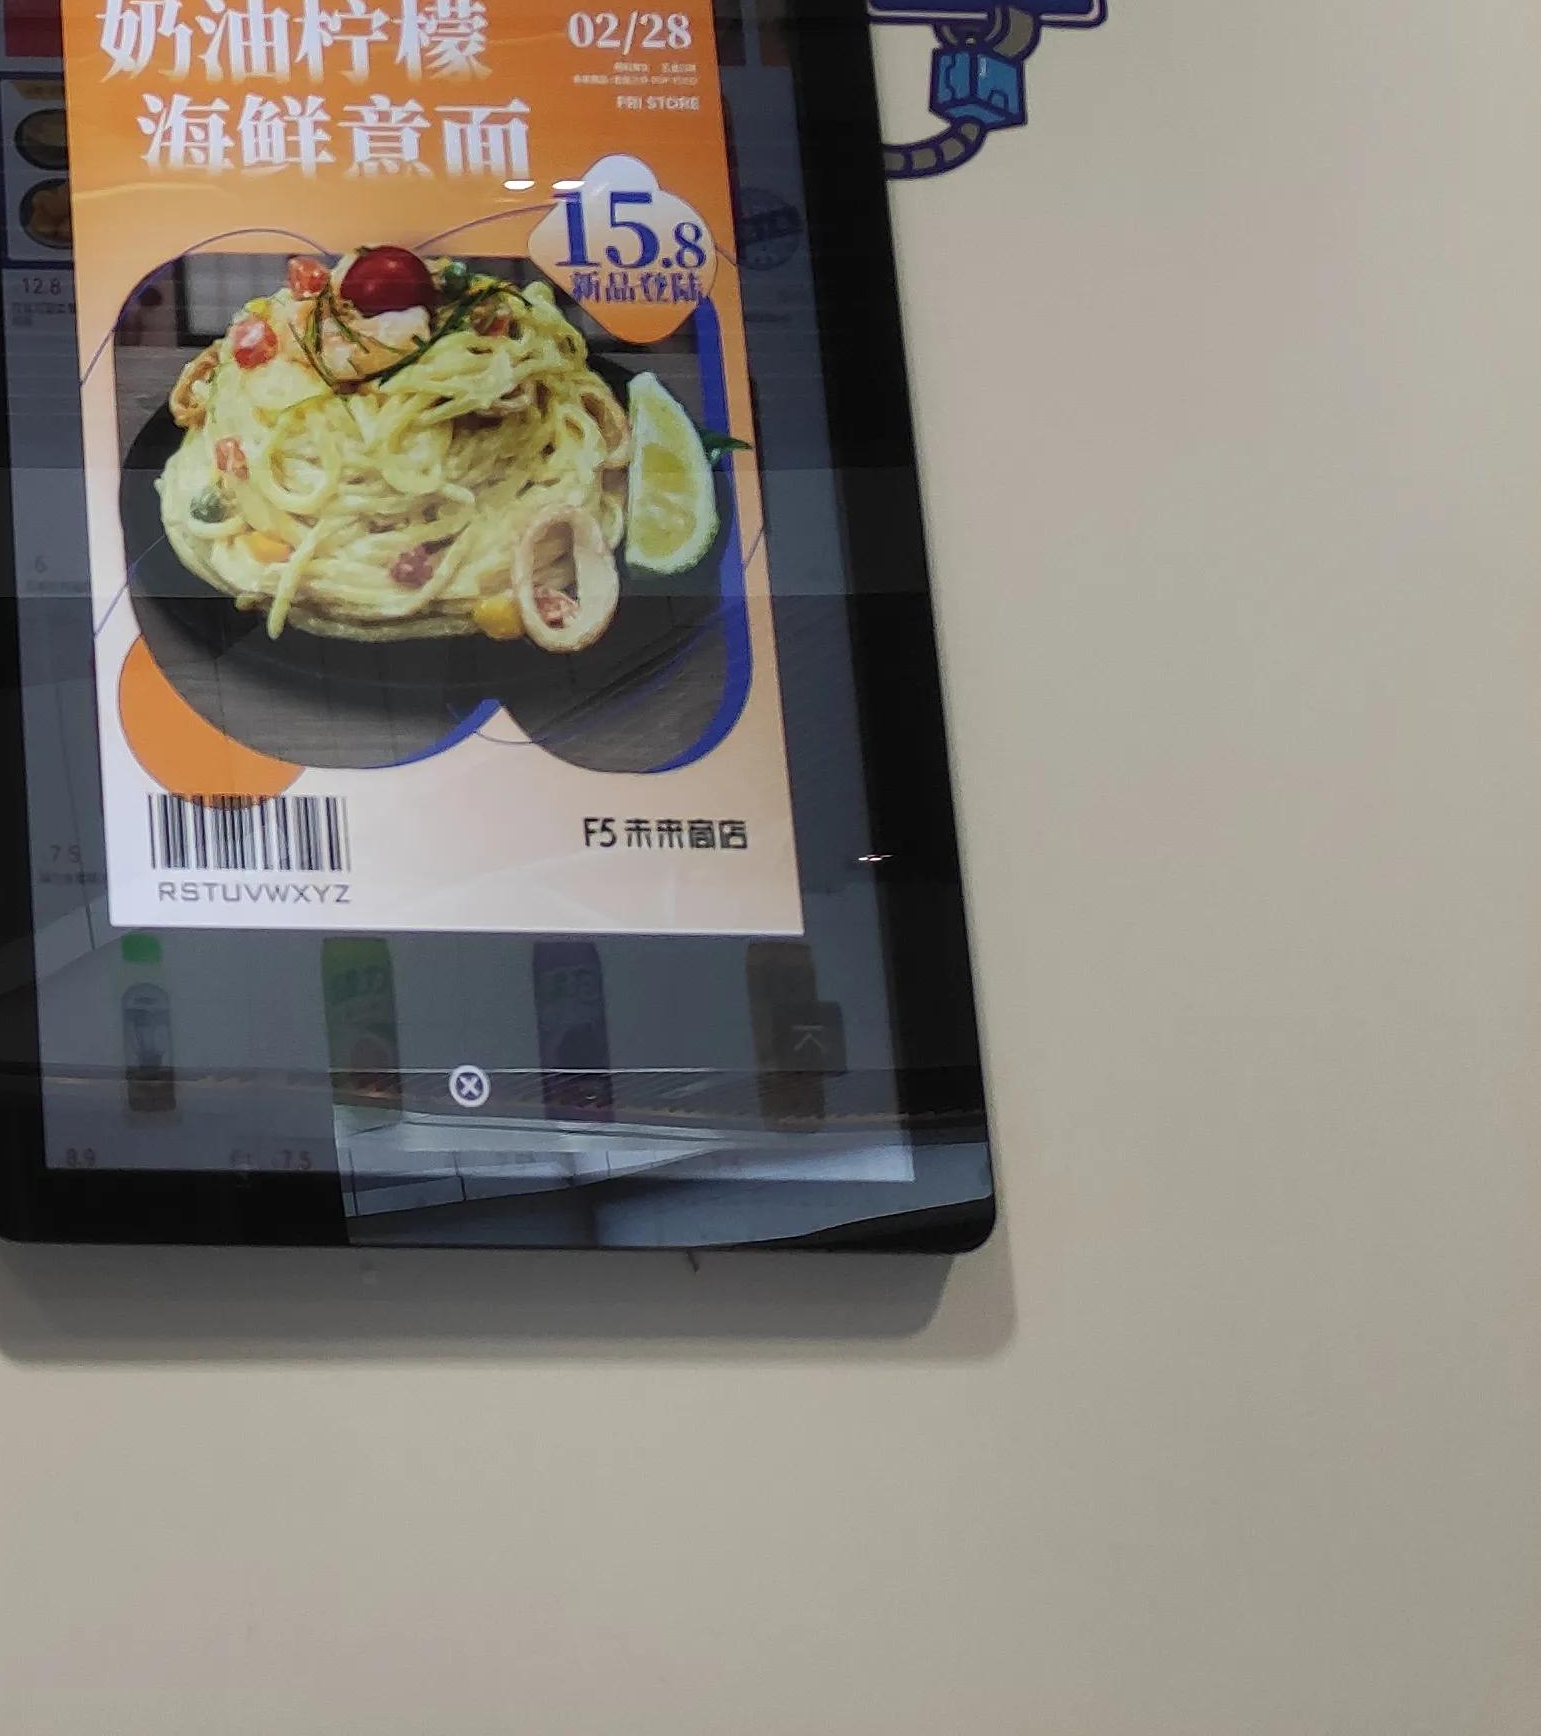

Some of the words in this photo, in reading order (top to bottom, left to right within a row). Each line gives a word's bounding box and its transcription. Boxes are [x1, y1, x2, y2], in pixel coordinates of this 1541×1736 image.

[567, 11, 692, 55] 02/28
[136, 93, 531, 180] 海鲜意面
[554, 191, 707, 269] 15.8
[583, 817, 617, 848] F5
[624, 817, 749, 850] 未来商店
[158, 881, 352, 905] RSTUVWXYZ
